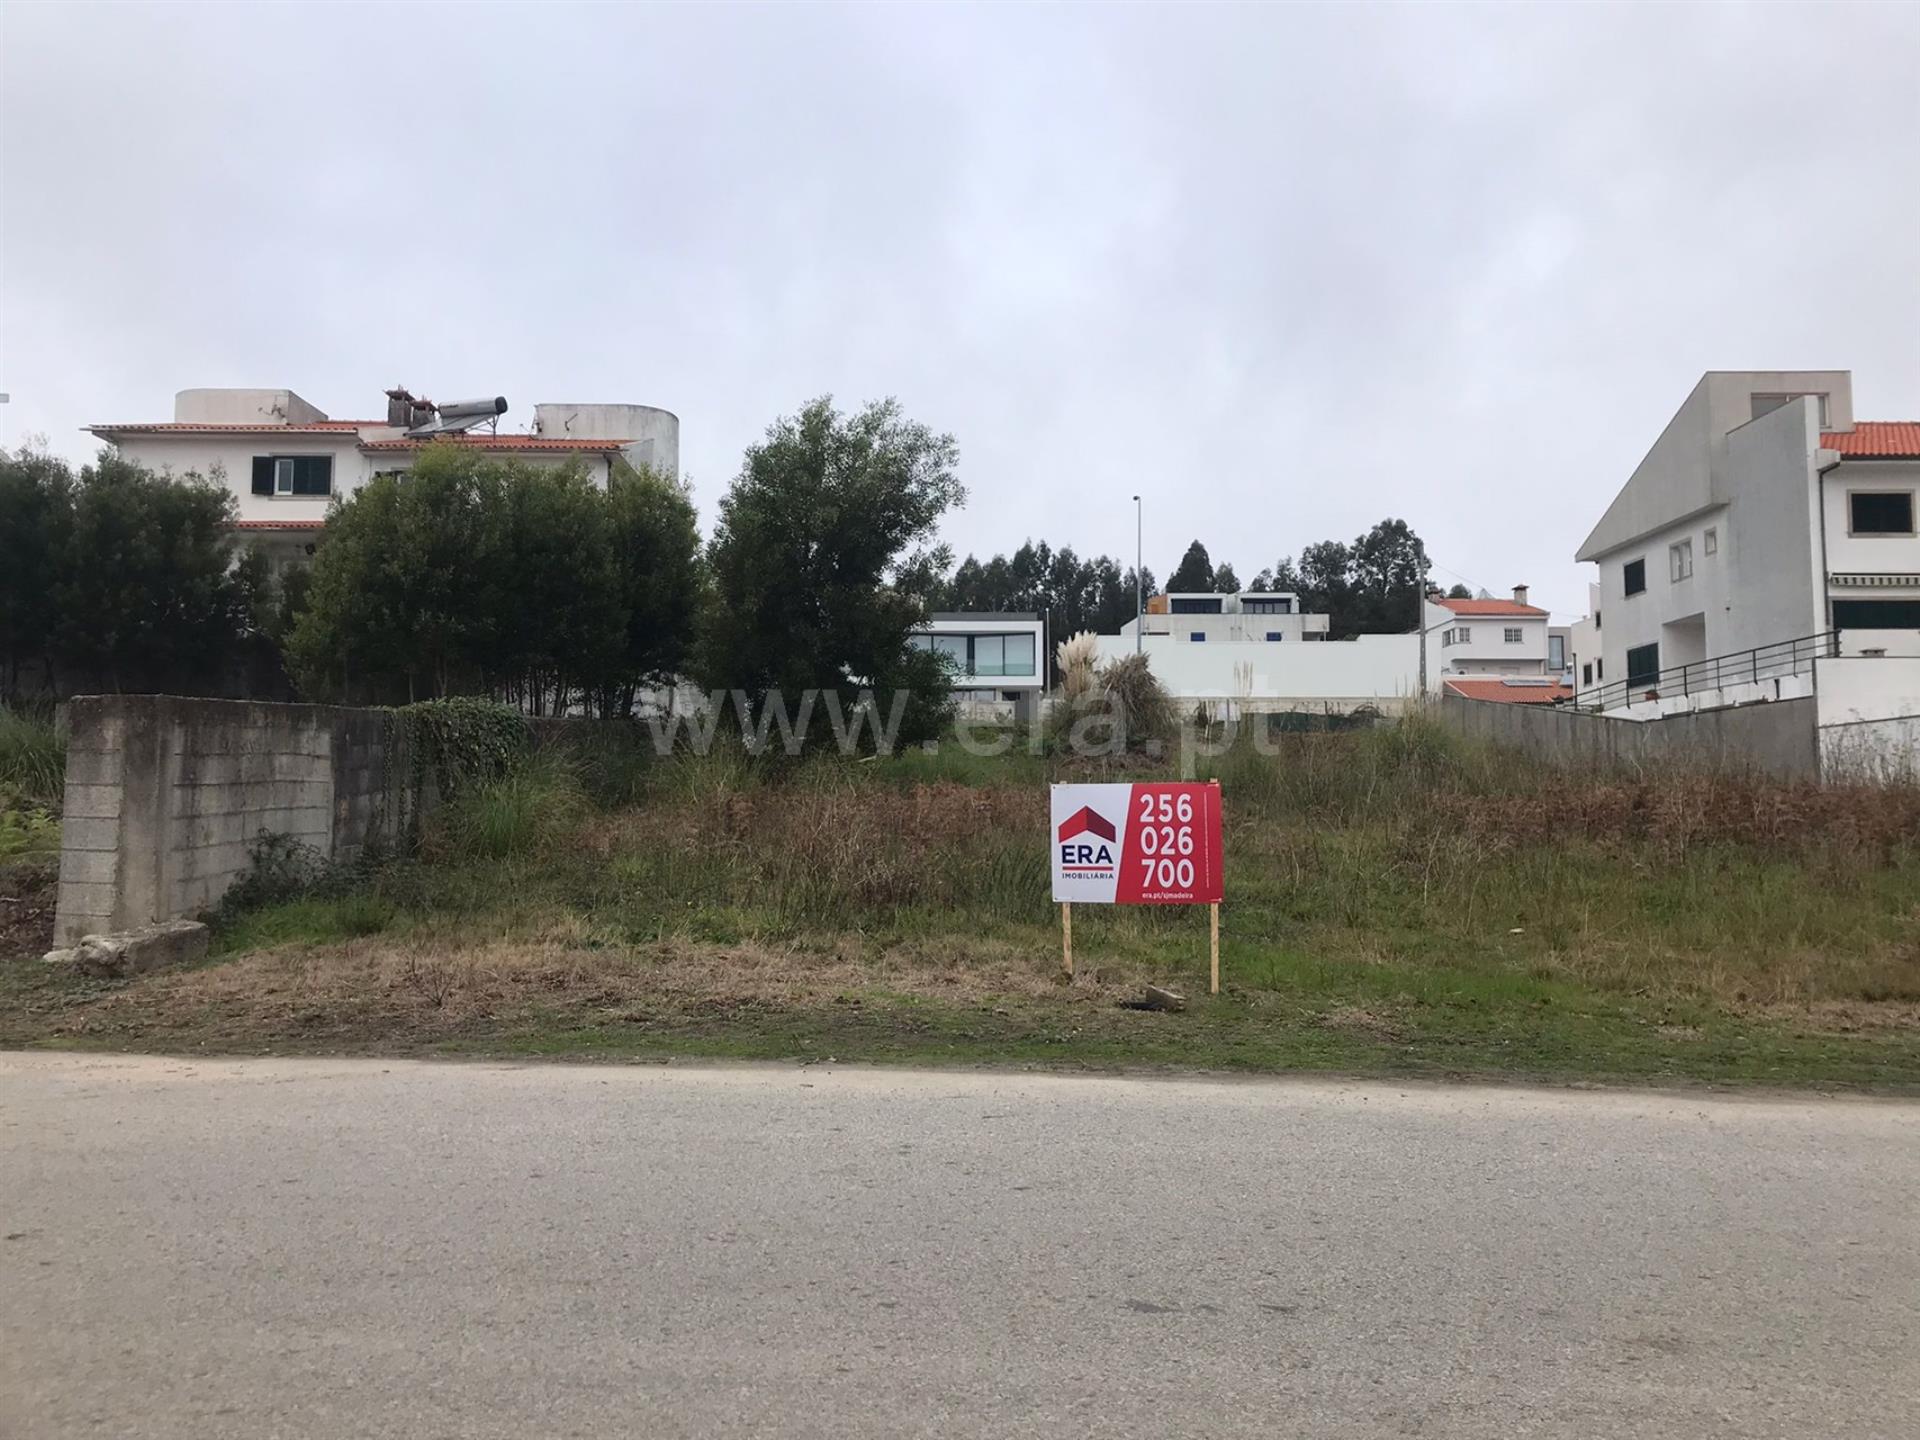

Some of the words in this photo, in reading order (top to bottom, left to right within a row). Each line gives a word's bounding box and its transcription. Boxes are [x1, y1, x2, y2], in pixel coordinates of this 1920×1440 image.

[1139, 793, 1193, 823] 256
[1062, 844, 1113, 864] ERA
[1140, 826, 1194, 856] 026
[1062, 871, 1114, 880] IMOBILIÁRIA
[1141, 858, 1195, 889] 700
